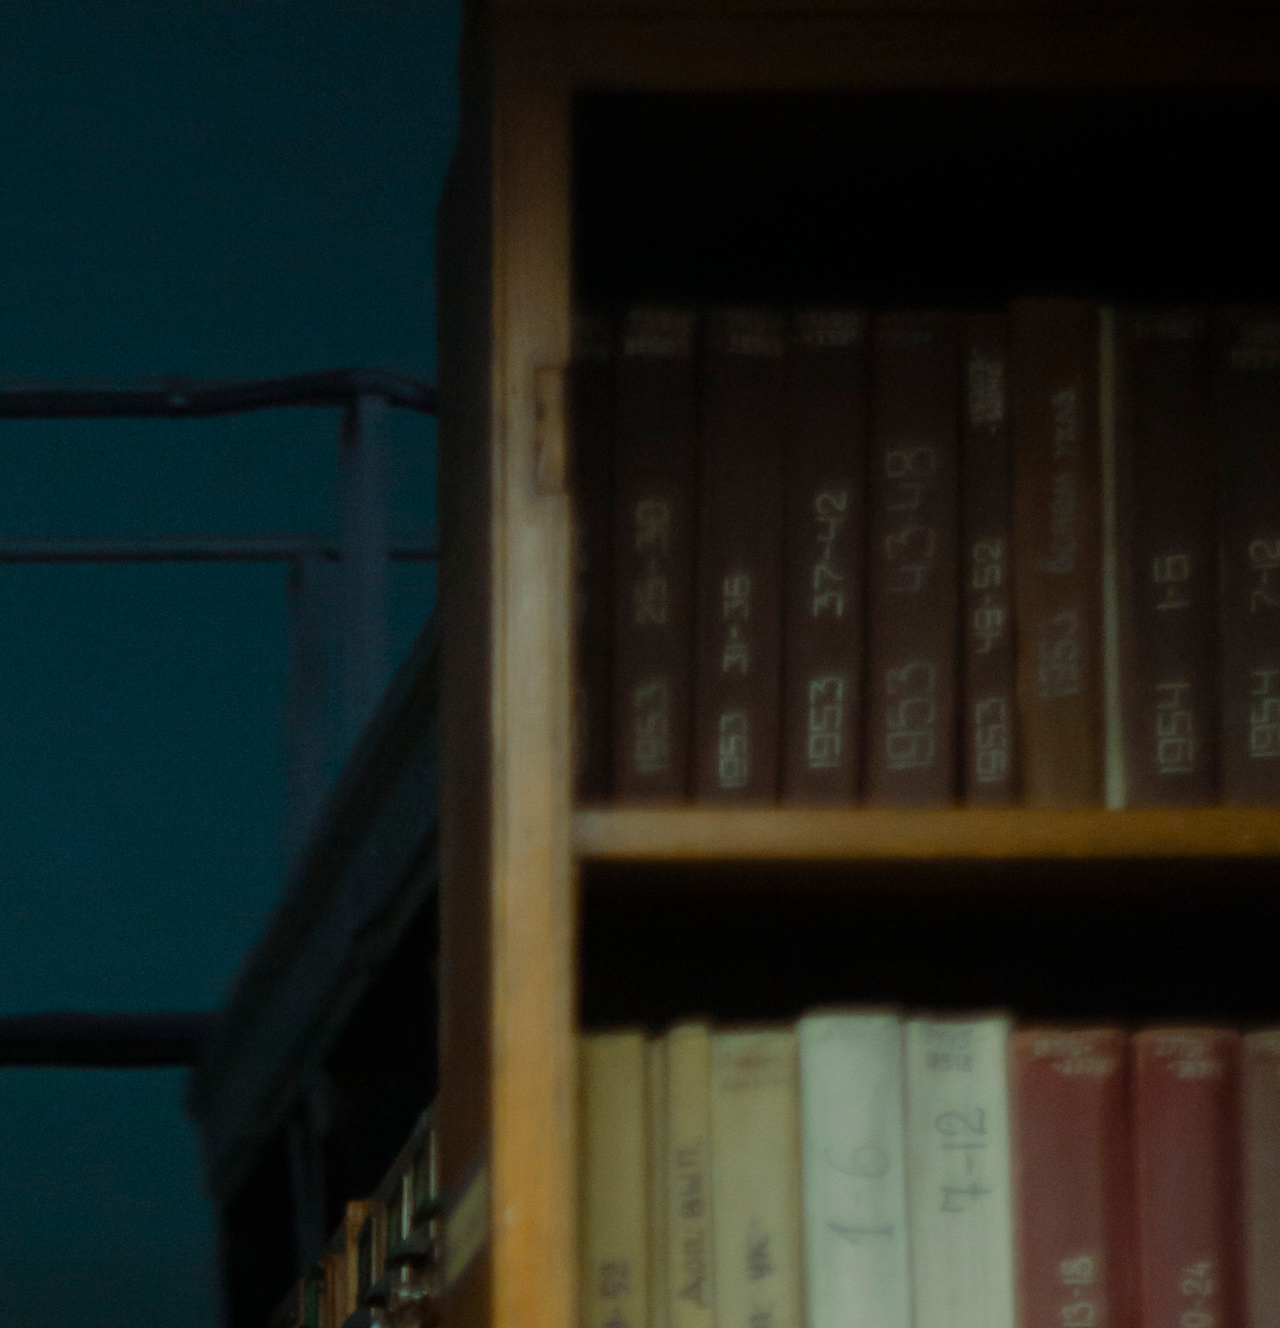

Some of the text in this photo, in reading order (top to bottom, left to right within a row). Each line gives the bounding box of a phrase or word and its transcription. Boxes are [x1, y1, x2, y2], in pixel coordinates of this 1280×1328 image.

[807, 490, 850, 769] 1953 37-42
[973, 541, 1010, 784] 1953 49-52
[1154, 550, 1196, 774] 1954 1-6
[718, 713, 750, 788] 1953
[886, 660, 937, 769] 1953
[1250, 670, 1280, 758] 1954
[936, 1105, 990, 1214] 7-12
[1060, 1256, 1093, 1328] 13-18
